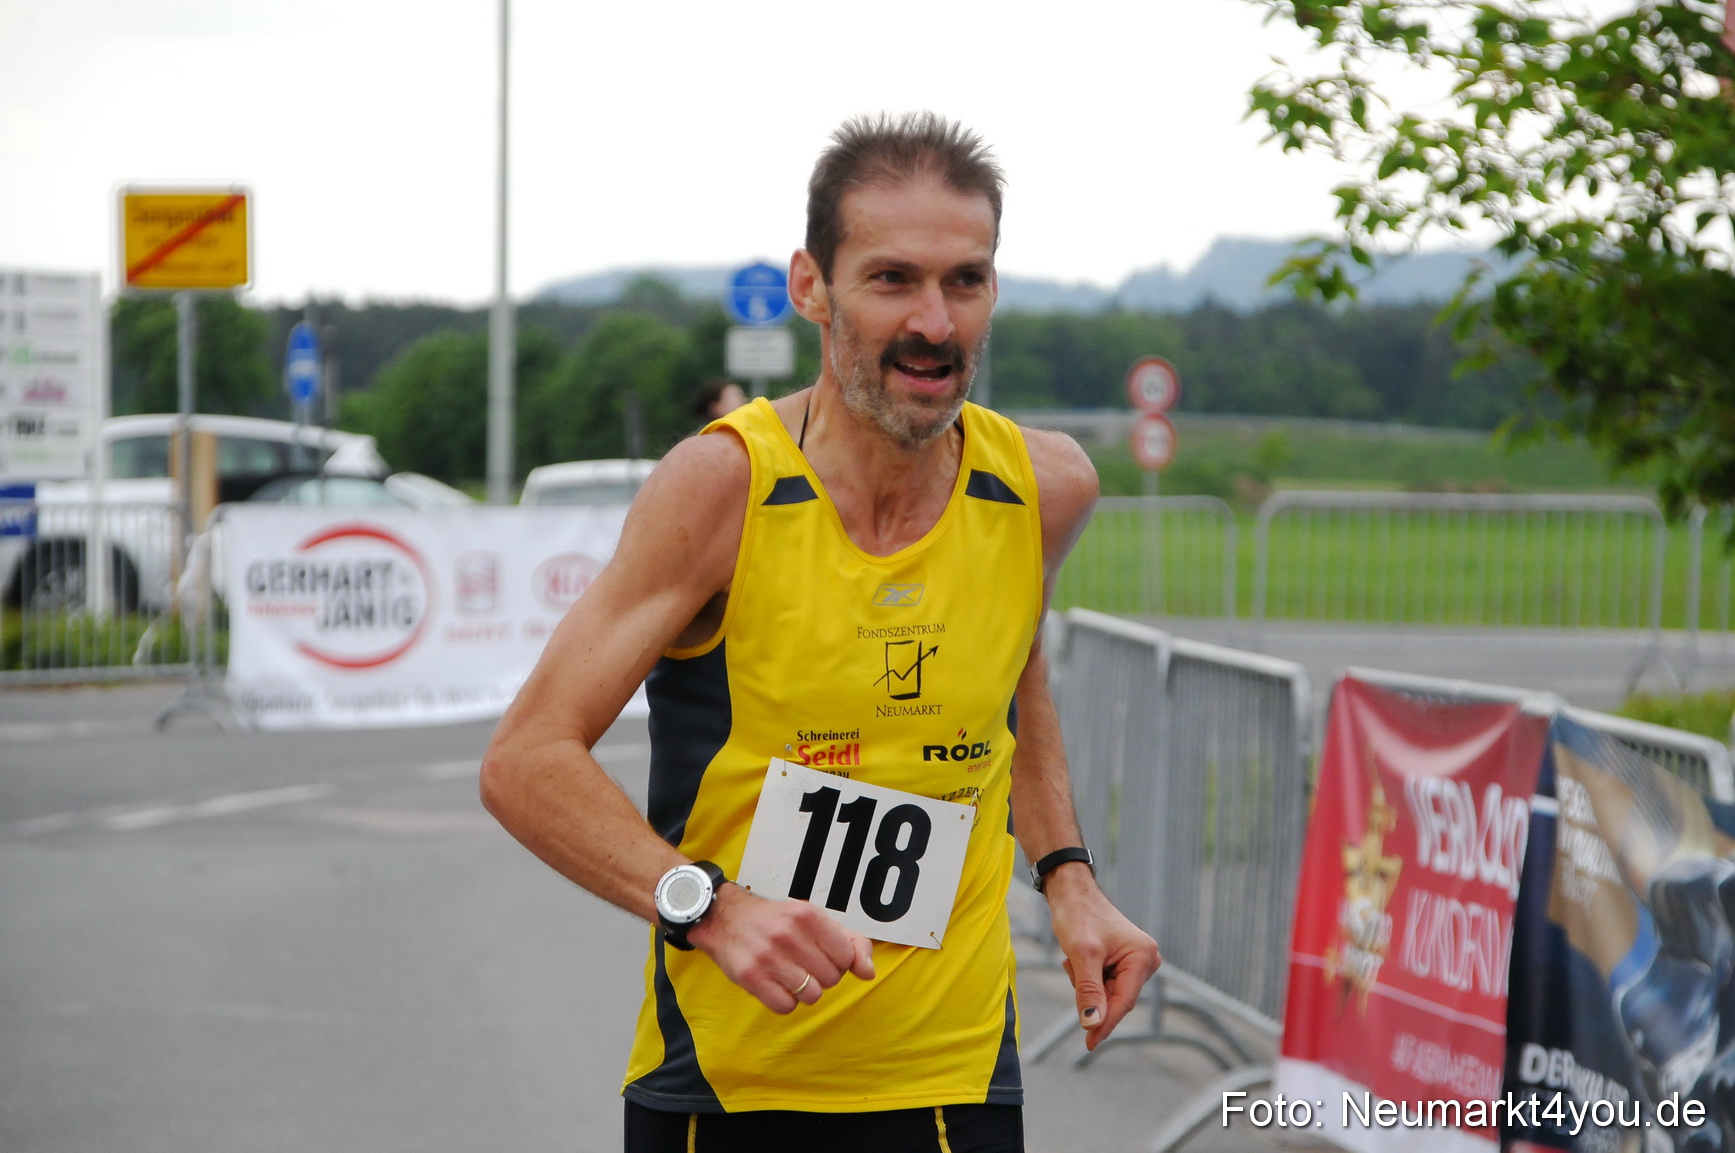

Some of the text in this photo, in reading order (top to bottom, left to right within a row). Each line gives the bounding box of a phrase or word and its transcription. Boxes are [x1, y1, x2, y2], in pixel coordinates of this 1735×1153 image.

[796, 728, 860, 741] Schreinerei
[797, 743, 861, 766] Seidl
[787, 785, 932, 923] 118
